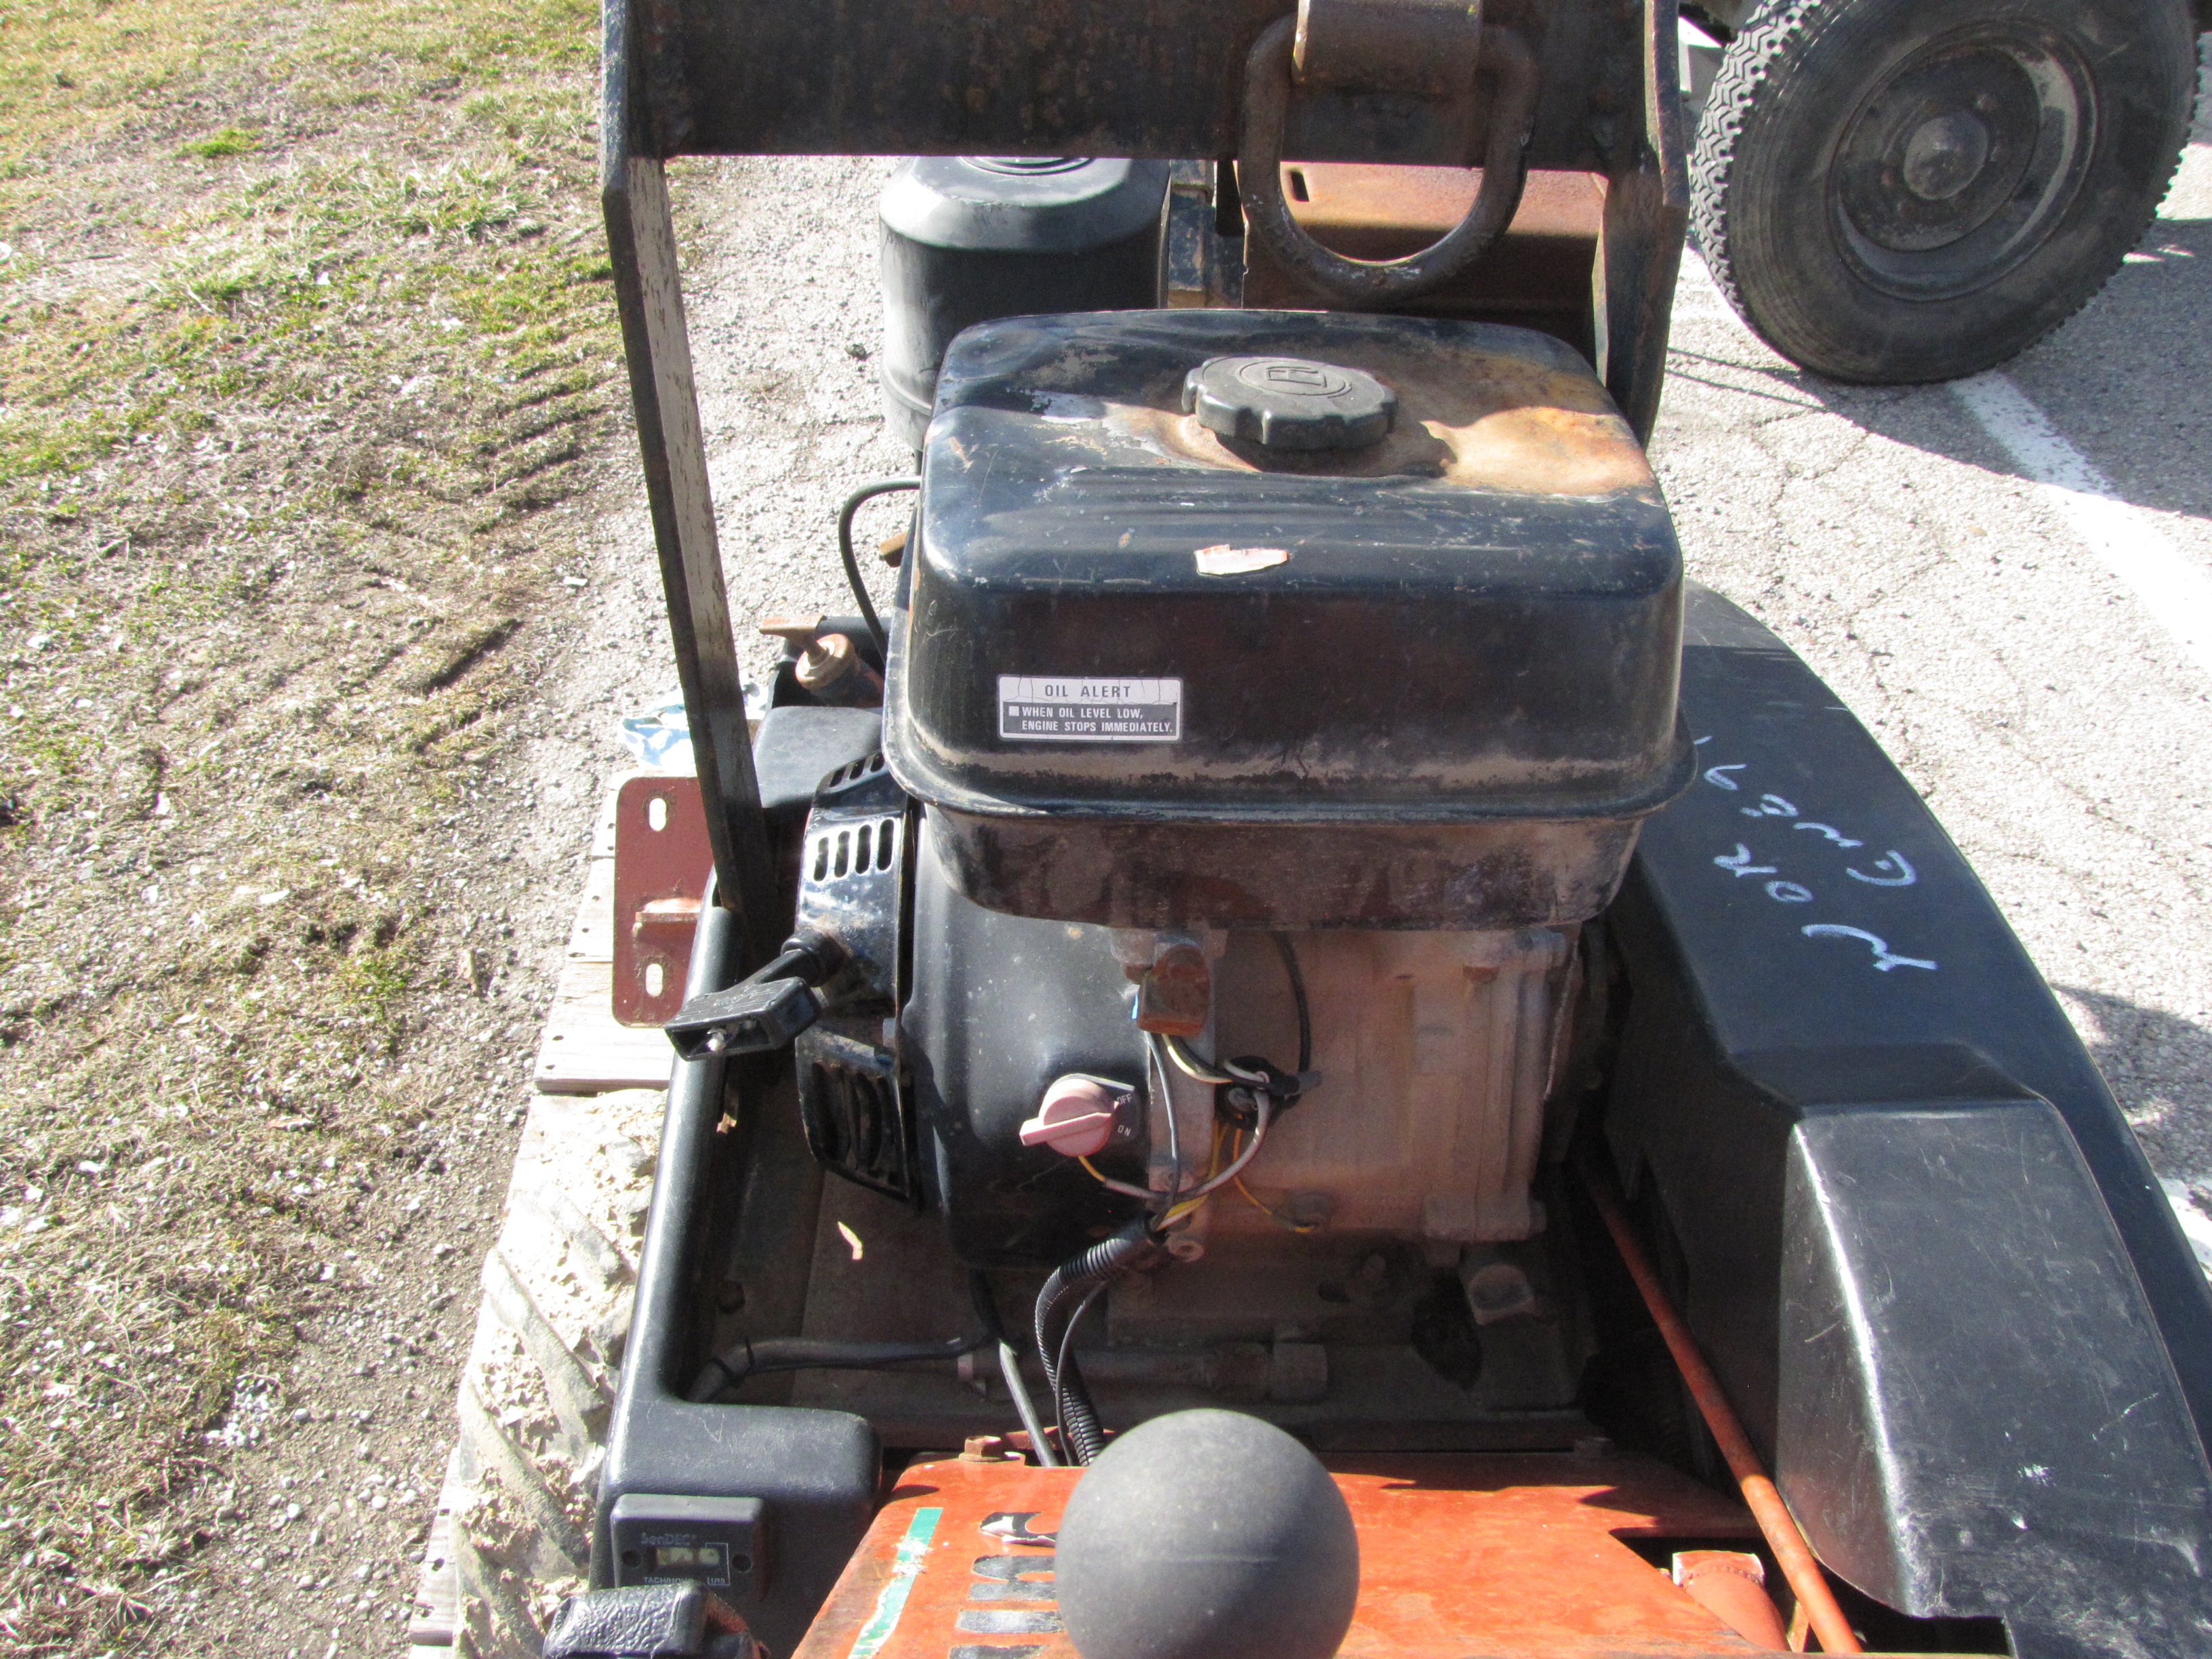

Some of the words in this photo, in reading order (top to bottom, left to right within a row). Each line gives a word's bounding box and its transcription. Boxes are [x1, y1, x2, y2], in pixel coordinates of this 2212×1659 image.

[1044, 684, 1069, 697] OIL
[1080, 685, 1130, 698] ALERT
[1021, 706, 1053, 718] WHEN
[1059, 707, 1076, 718] OIL
[1080, 708, 1111, 718] LEVEL
[1117, 708, 1144, 719] LOW,
[1022, 720, 1059, 731] ENGINE
[1064, 721, 1097, 732] STOPS
[1101, 722, 1173, 733] IMMEDIATELY.
[1117, 1093, 1132, 1105] OFF
[1118, 1125, 1131, 1136] ON
